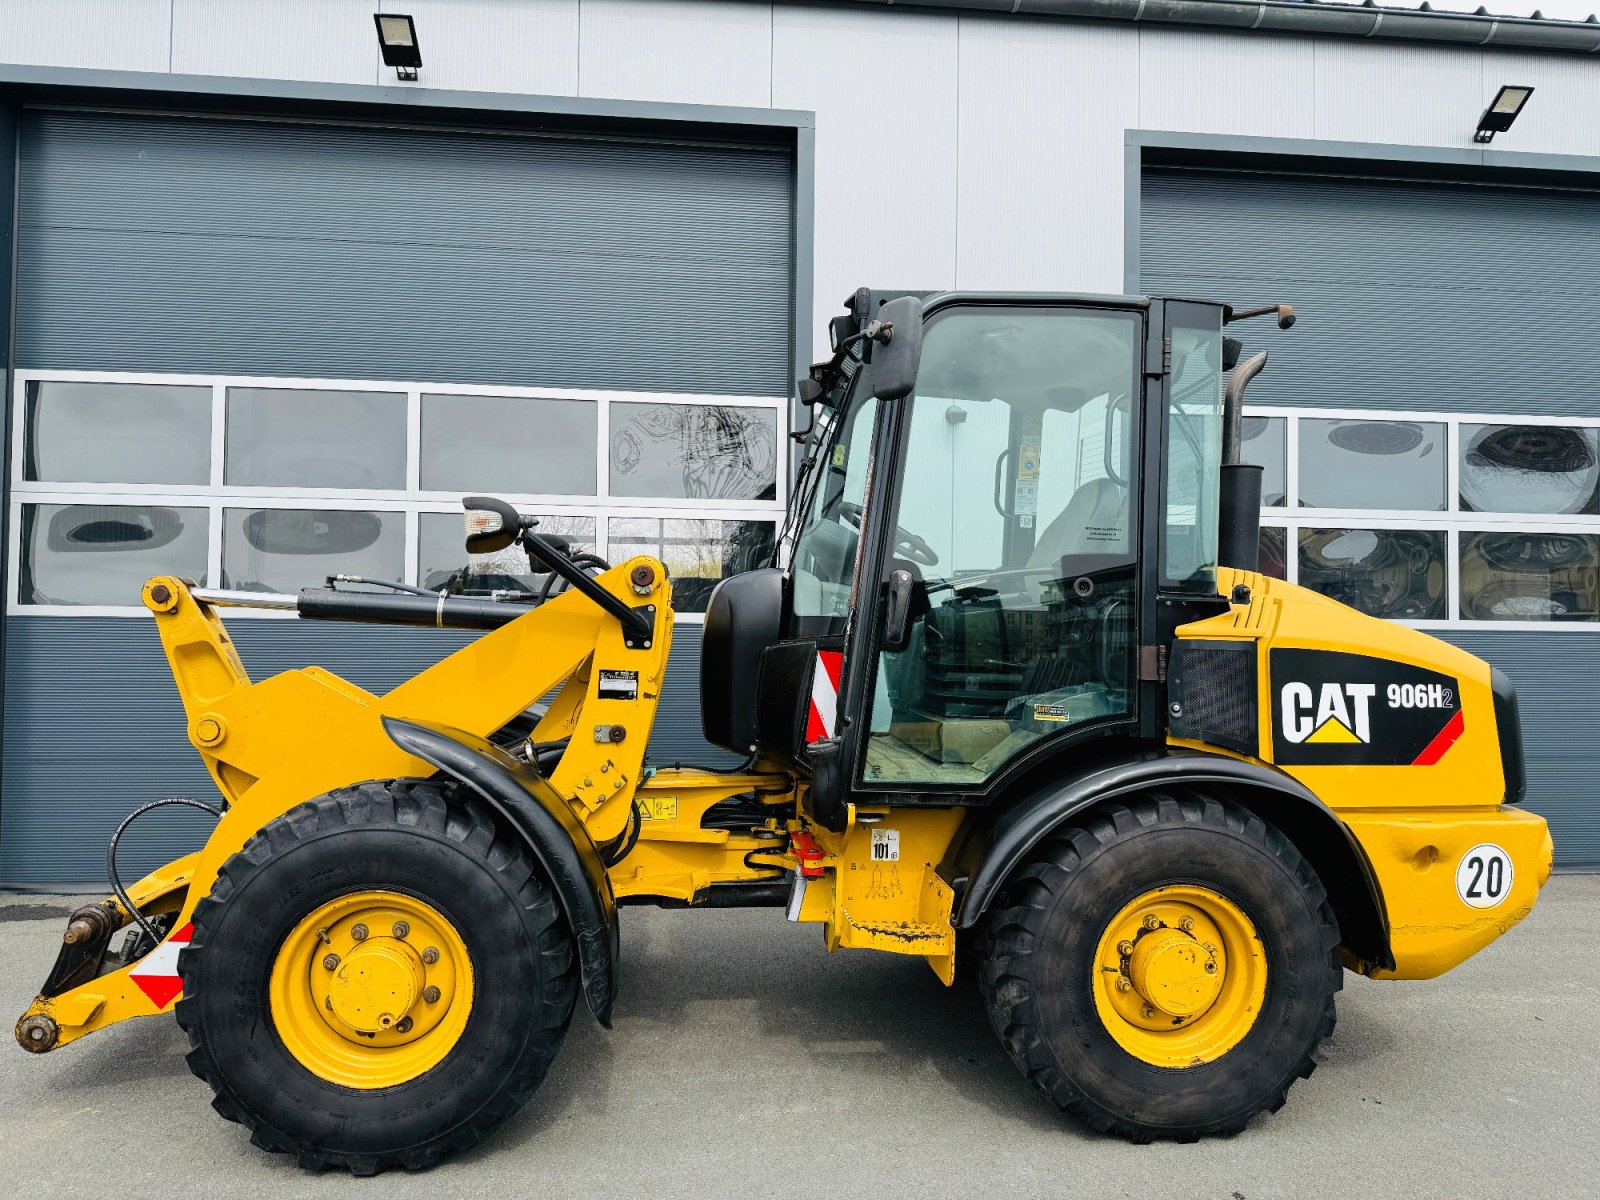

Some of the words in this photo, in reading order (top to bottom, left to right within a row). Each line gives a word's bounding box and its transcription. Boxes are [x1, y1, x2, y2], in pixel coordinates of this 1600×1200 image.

[1281, 681, 1376, 744] CAT
[873, 842, 889, 859] 101
[1466, 856, 1503, 898] 20
